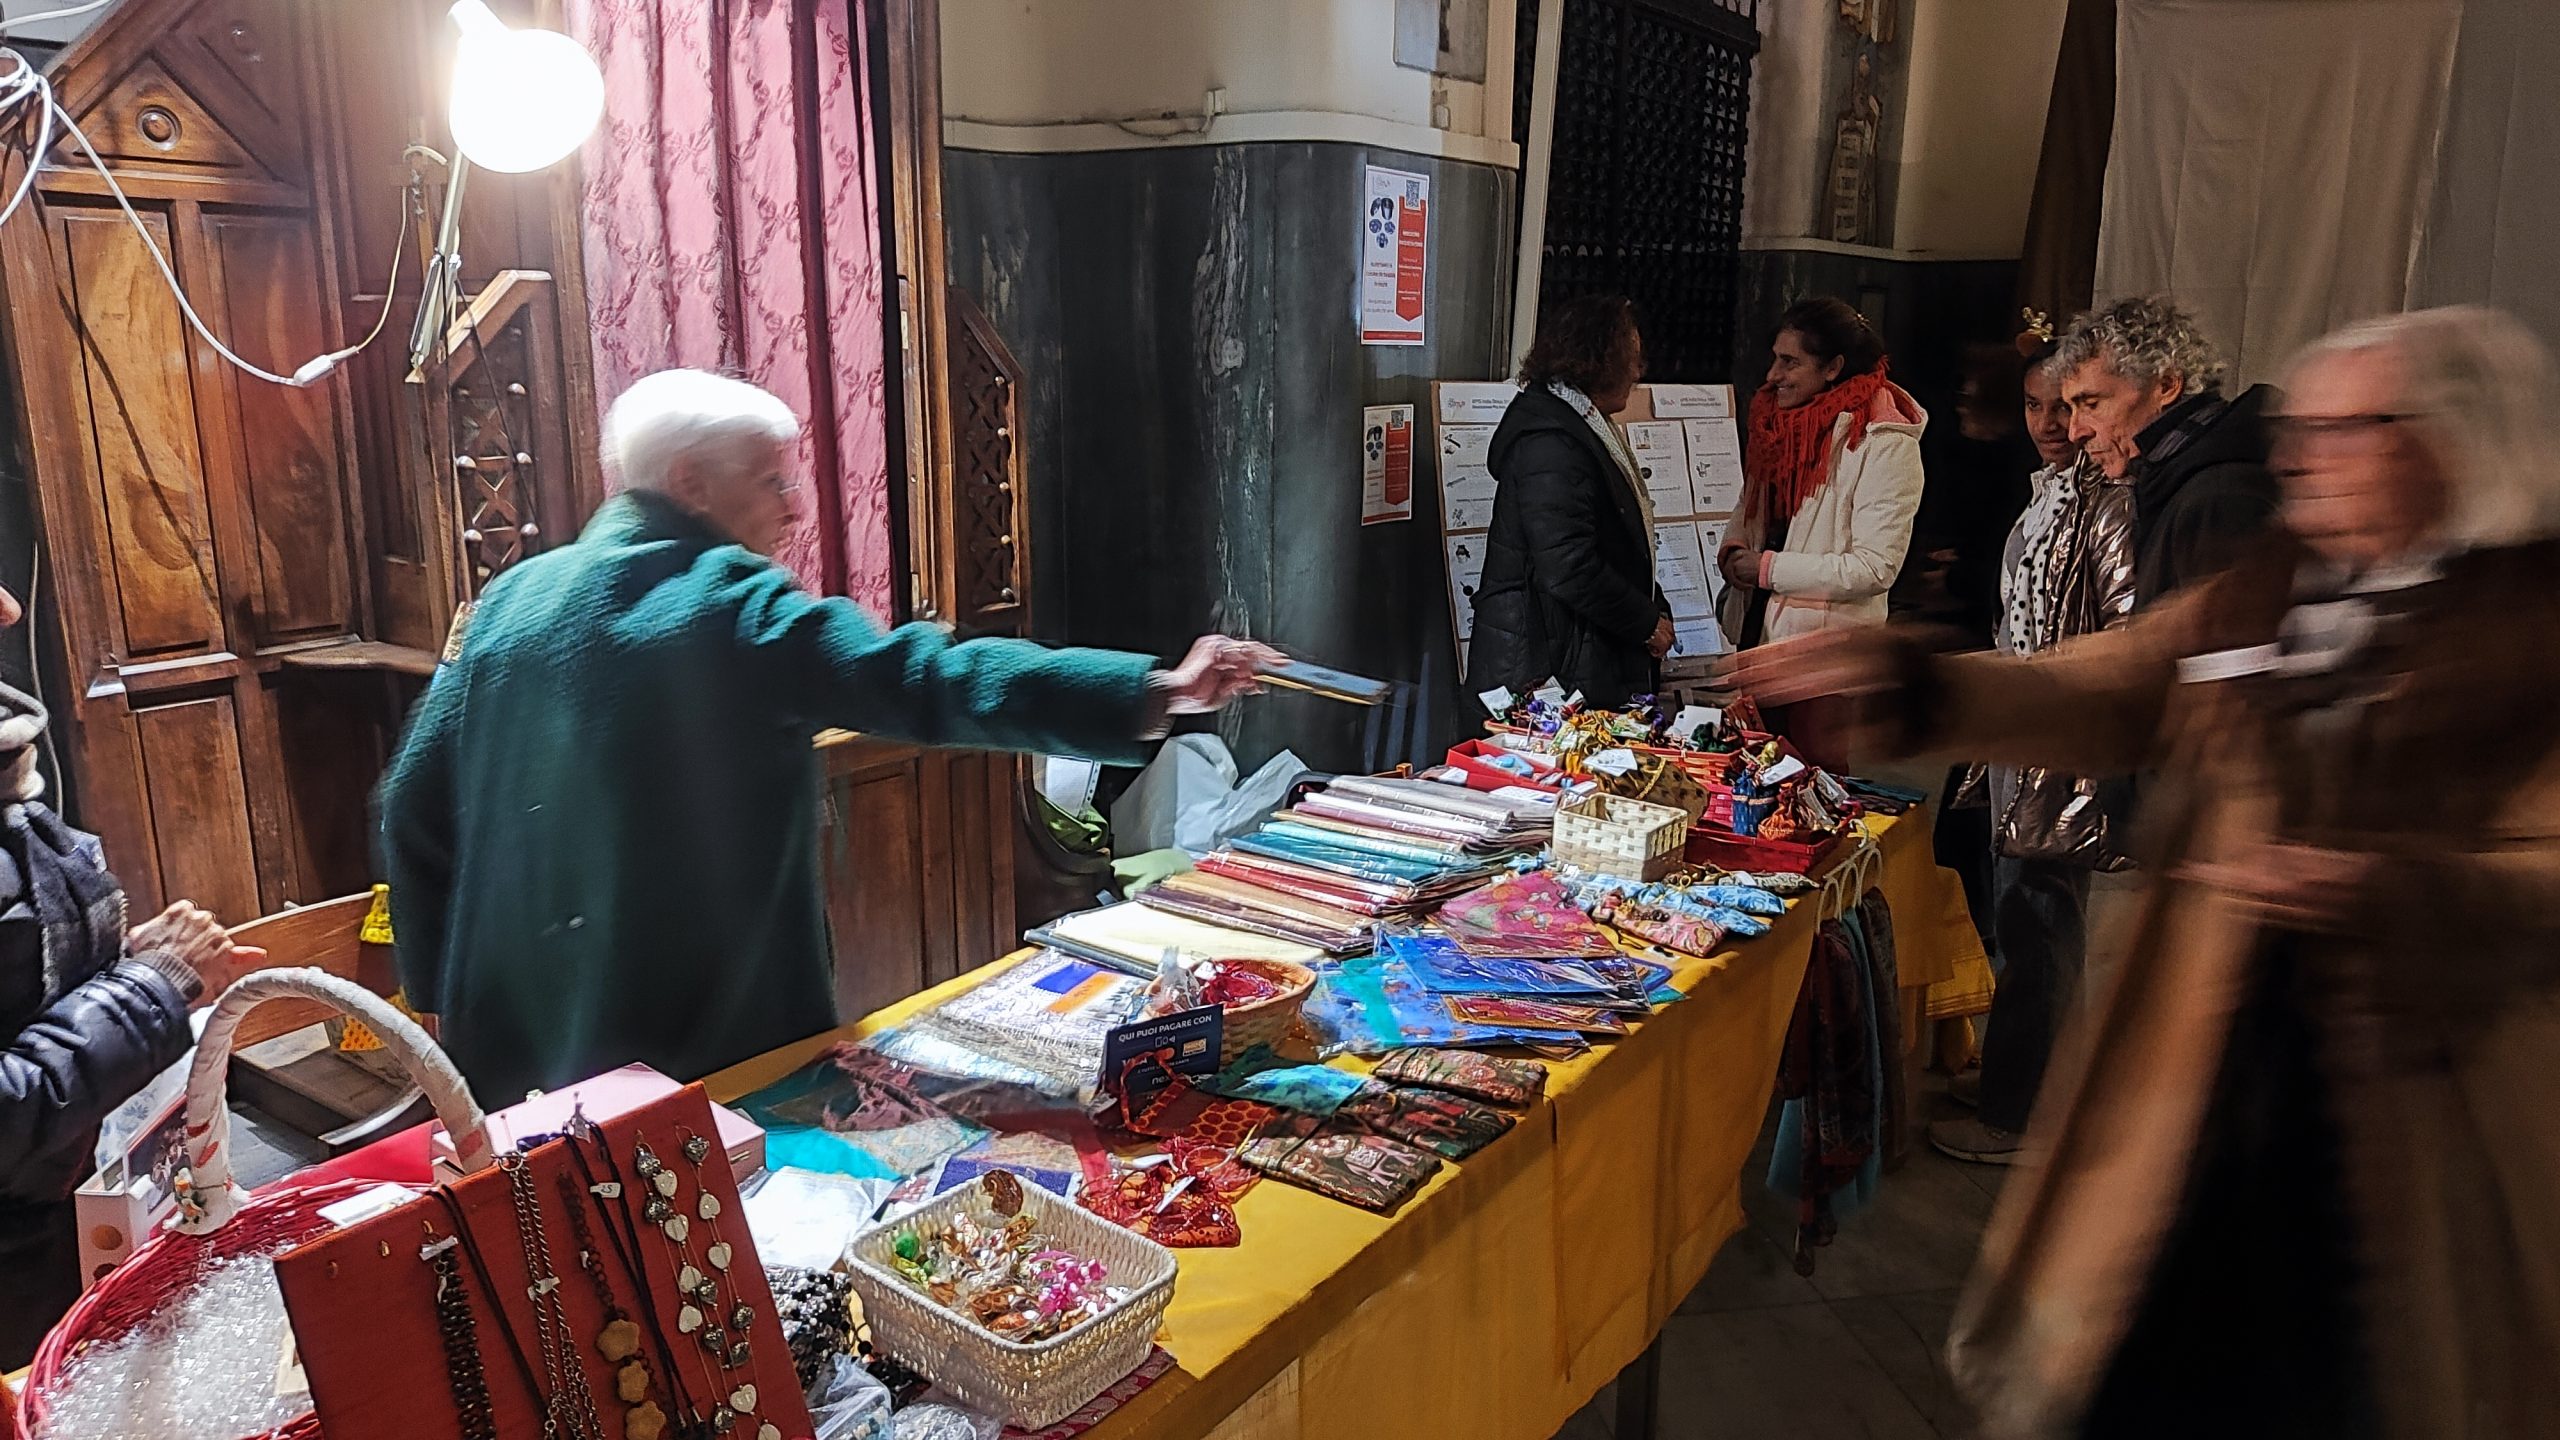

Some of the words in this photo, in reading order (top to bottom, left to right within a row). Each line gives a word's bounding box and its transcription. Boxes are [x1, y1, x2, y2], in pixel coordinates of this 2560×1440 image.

[1118, 1032, 1135, 1042] QUI
[1136, 1027, 1158, 1038] PUOI
[1159, 1019, 1192, 1032] PAGARE
[1193, 1015, 1212, 1025] CON
[1152, 1076, 1170, 1085] nex
